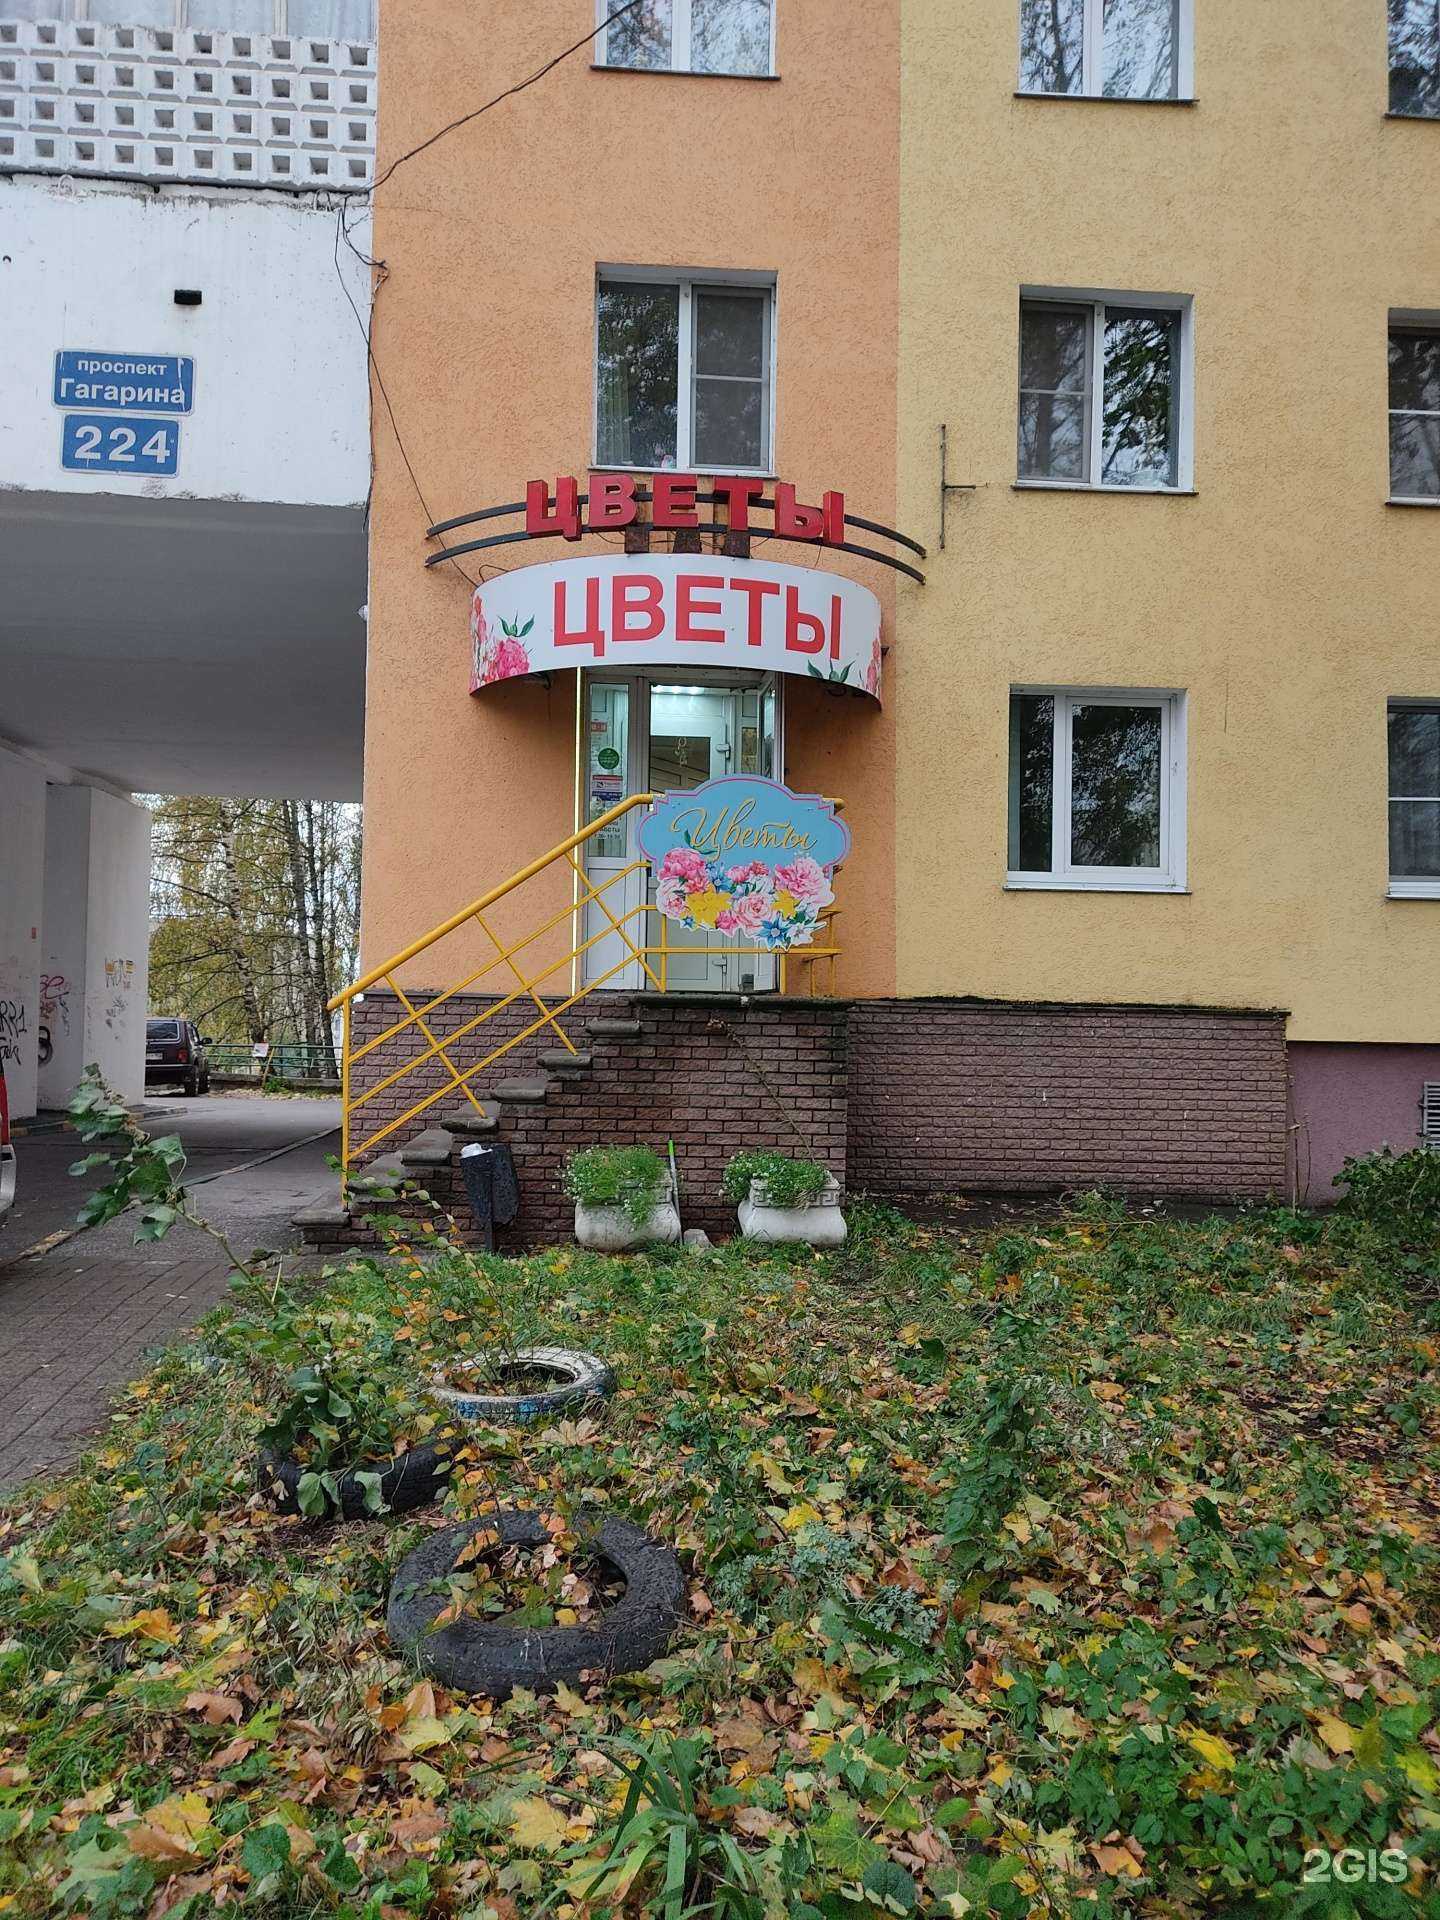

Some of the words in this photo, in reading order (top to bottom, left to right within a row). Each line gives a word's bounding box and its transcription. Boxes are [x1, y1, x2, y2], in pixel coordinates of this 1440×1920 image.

[60, 378, 185, 406] Гагарина
[77, 359, 168, 376] проспект
[74, 425, 170, 464] 224
[526, 474, 845, 542] ЦВЕТЫ
[554, 574, 841, 660] ЦВЕТЫ
[671, 799, 817, 862] Цветы
